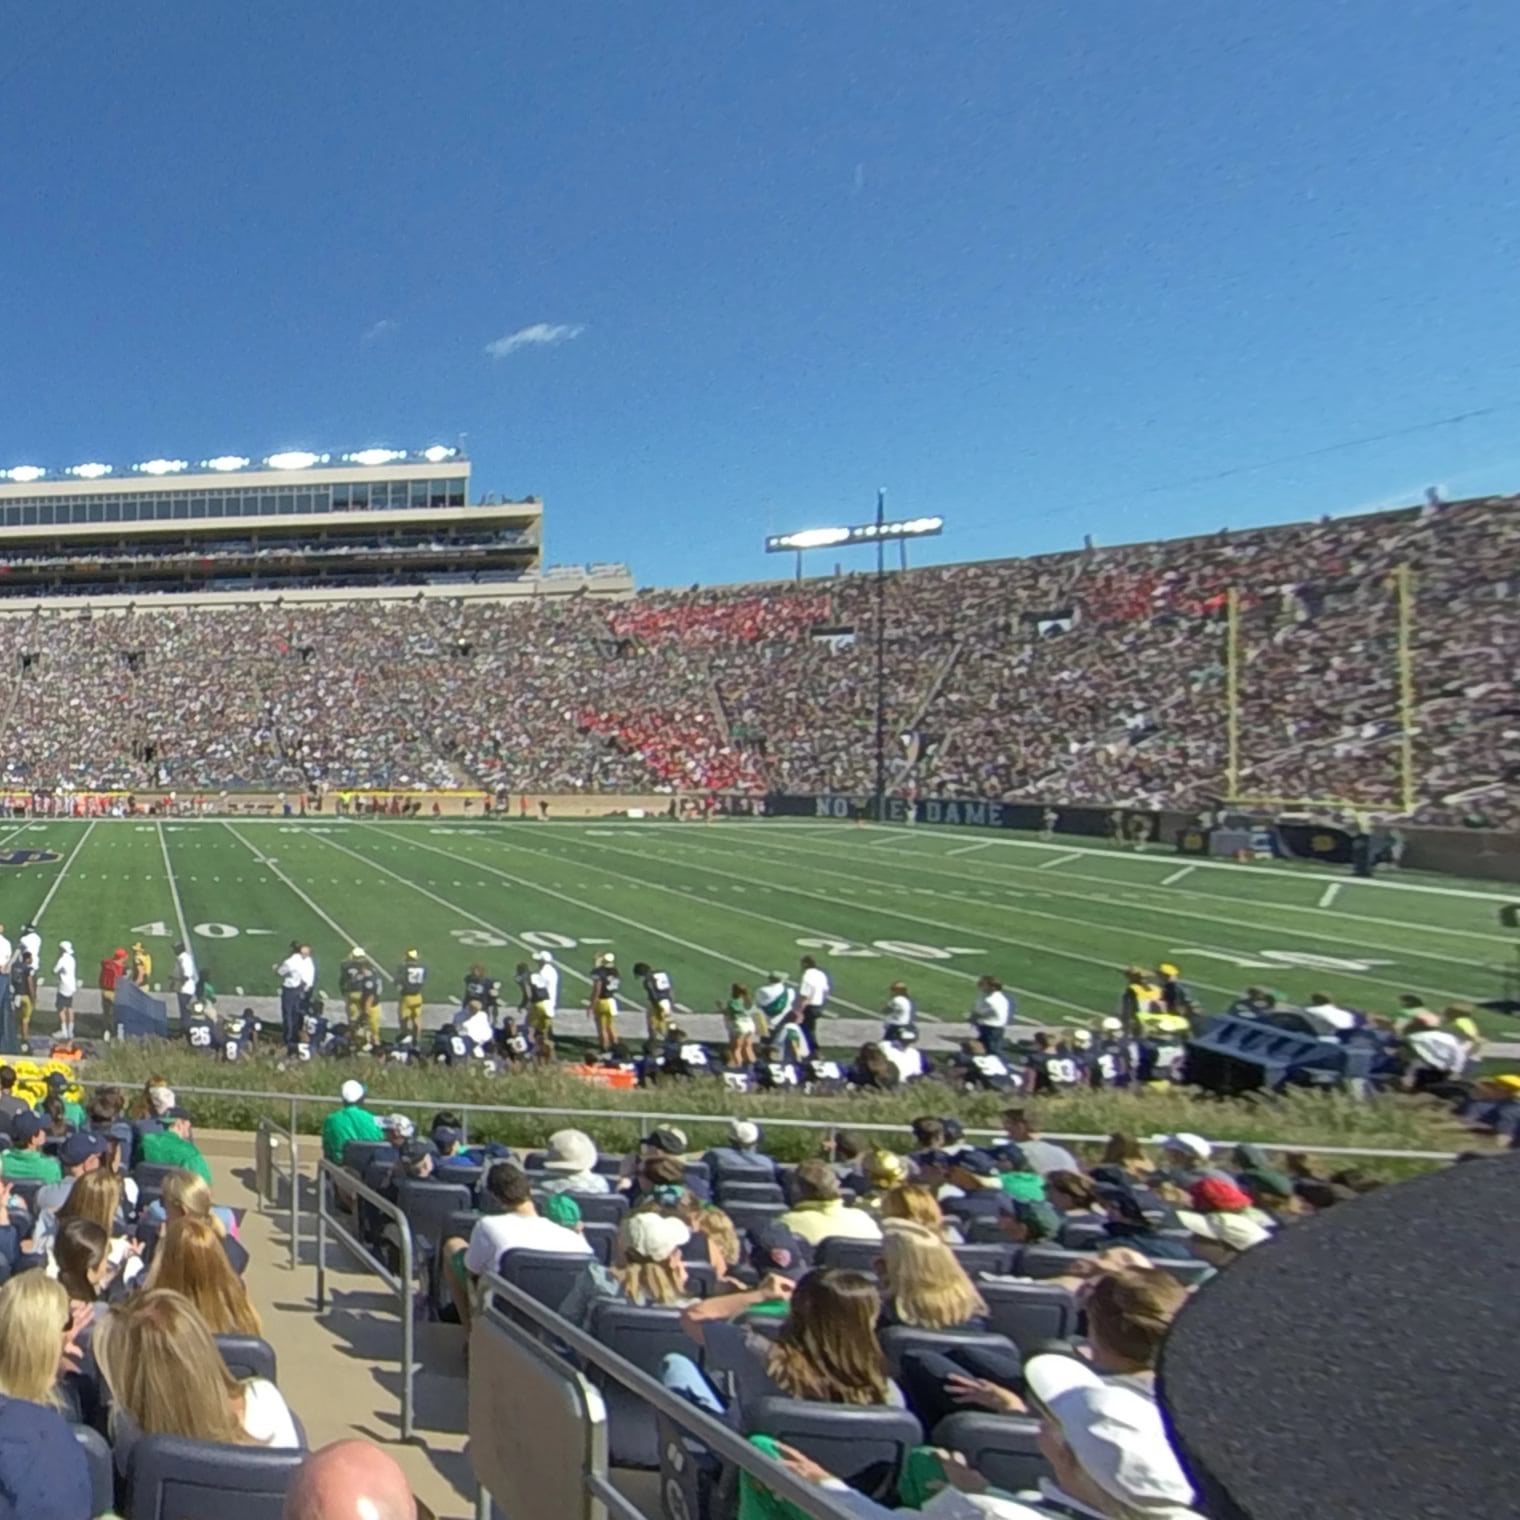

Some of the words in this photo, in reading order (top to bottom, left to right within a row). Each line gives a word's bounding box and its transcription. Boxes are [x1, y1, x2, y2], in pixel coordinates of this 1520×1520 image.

[814, 797, 904, 820] NOE
[926, 801, 1002, 826] DAME
[129, 920, 240, 939] 40
[448, 929, 577, 949] 30
[795, 938, 950, 959] 20
[188, 1026, 211, 1047] 26
[224, 1041, 238, 1061] 8
[297, 1042, 311, 1062] 5
